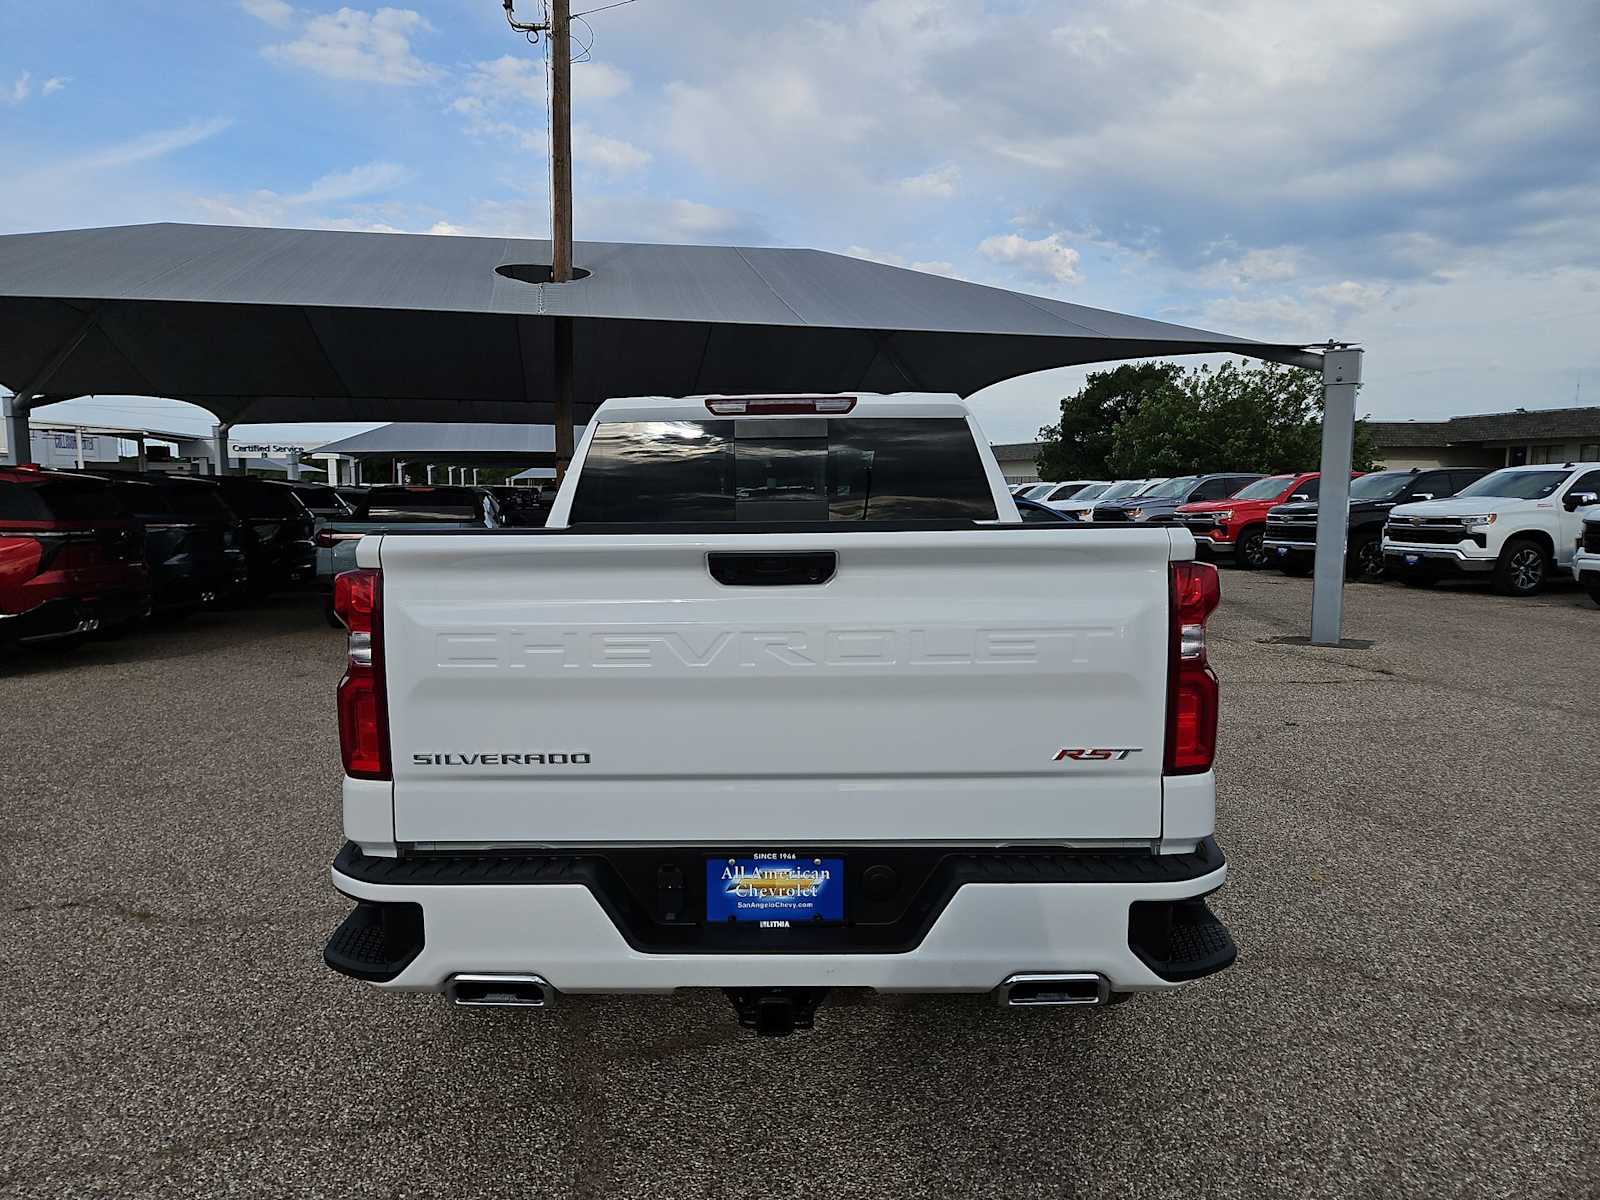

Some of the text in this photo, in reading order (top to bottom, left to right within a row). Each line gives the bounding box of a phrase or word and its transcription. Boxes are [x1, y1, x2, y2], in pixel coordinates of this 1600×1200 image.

[232, 444, 304, 454] Certified Service
[436, 626, 1124, 669] CHEVROLET
[413, 753, 591, 766] SILVERADO
[1051, 748, 1143, 760] RST
[721, 866, 830, 880] All American
[735, 884, 818, 898] Chevrolet
[737, 901, 814, 909] SanAngeloChevy.com
